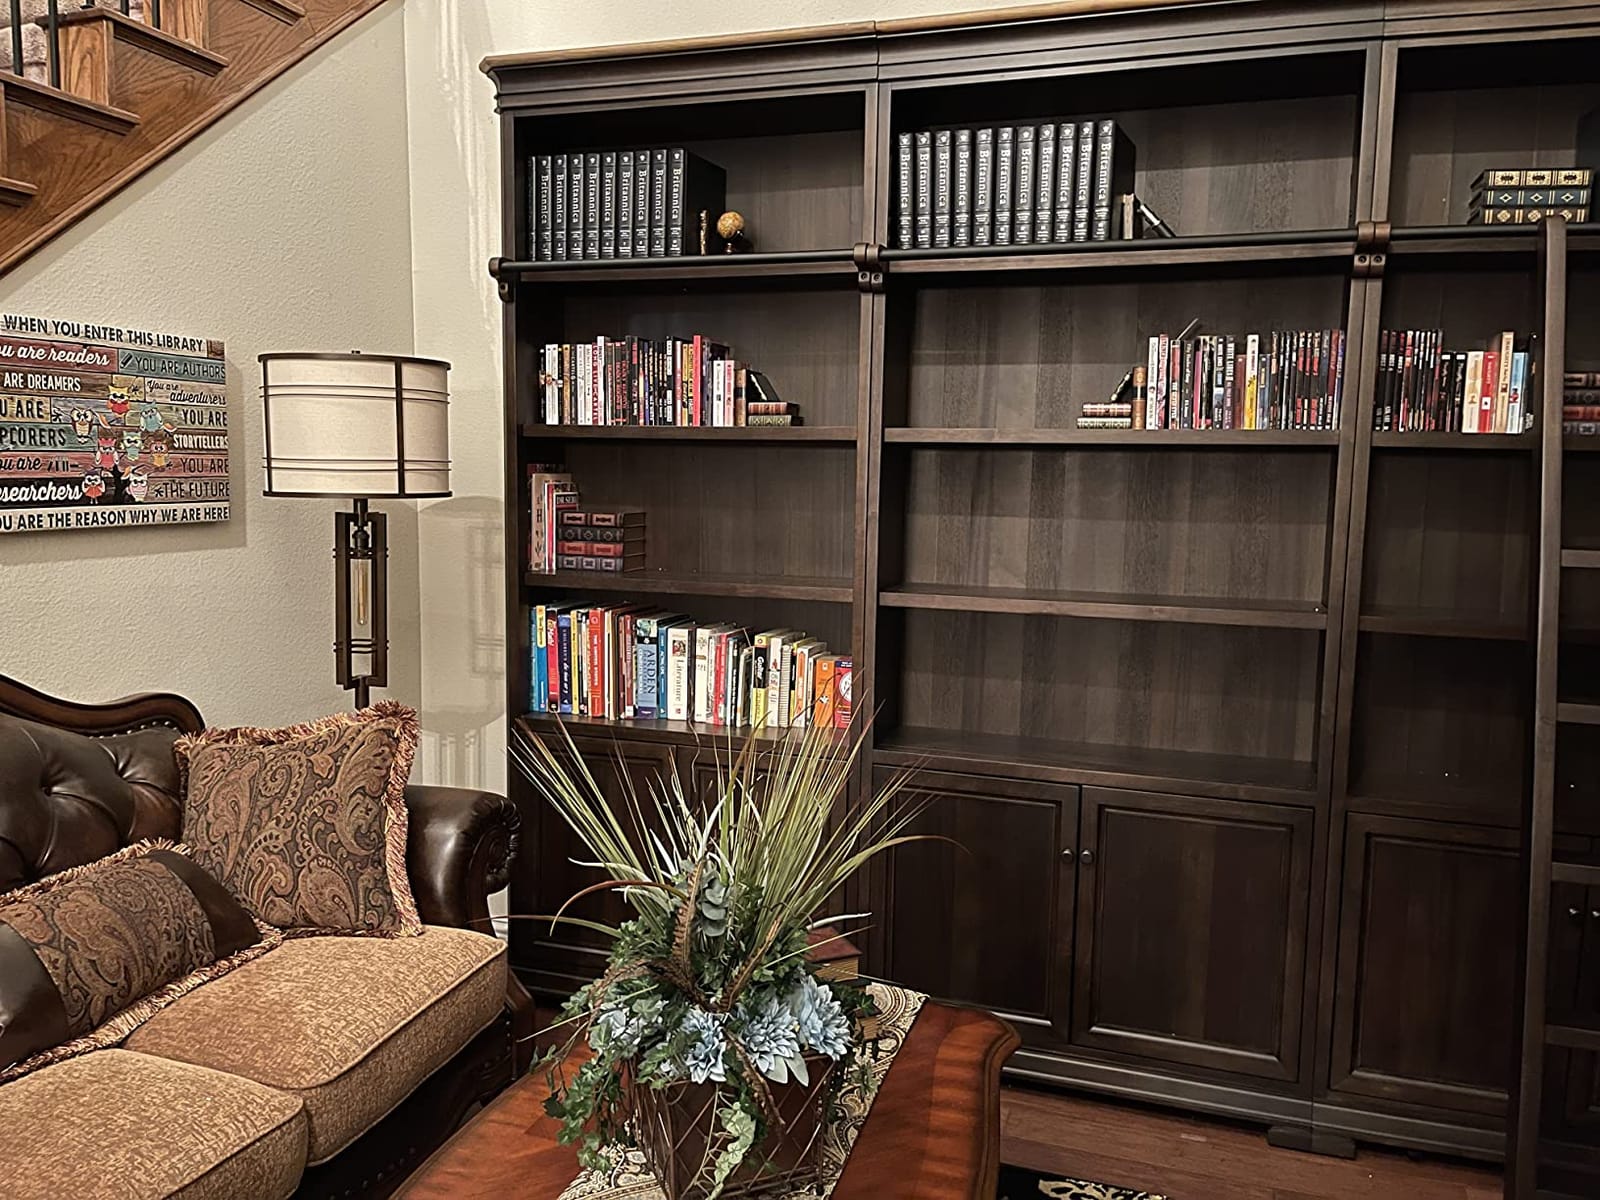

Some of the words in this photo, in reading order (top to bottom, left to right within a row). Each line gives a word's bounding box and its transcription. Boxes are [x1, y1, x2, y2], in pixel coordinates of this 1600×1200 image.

[638, 170, 647, 221] Britannica
[655, 170, 664, 220] Britannica
[672, 168, 682, 219] Britannica
[901, 154, 910, 208] Britannica
[920, 154, 929, 208] Britannica
[939, 152, 949, 207] Britannica
[959, 151, 968, 206] Britannica
[978, 150, 989, 205] Britannica
[1000, 149, 1010, 205] Britannica
[1020, 148, 1031, 204] Britannica
[1041, 147, 1052, 203] Britannica
[1060, 145, 1073, 202] Britannica
[1079, 144, 1091, 201] Britannica
[1099, 142, 1111, 200] Britannica
[540, 175, 548, 224] Britannica
[556, 174, 564, 223] Britannica
[572, 173, 580, 223] Britannica
[588, 173, 597, 222] Britannica
[605, 172, 613, 222] Britannica
[621, 171, 630, 221] Britannica
[4, 315, 47, 333] WHEN
[52, 320, 80, 337] YOU
[85, 325, 123, 342] ENTER
[127, 330, 153, 346] THIS
[156, 334, 203, 351] LIBRARY
[17, 346, 47, 359] are
[48, 347, 110, 366] readers
[4, 372, 24, 387] ARE
[28, 374, 81, 391] DREAMERS
[136, 357, 156, 372] YOU
[160, 360, 179, 374] ARE
[183, 362, 226, 378] AUTHORS
[147, 380, 165, 392] You
[16, 400, 44, 418] ARE
[182, 409, 203, 425] YOU
[209, 411, 227, 426] ARE
[17, 456, 42, 470] are
[173, 434, 229, 449] STORYTELLERS
[180, 458, 204, 473] YOU
[210, 459, 229, 473] ARE
[163, 482, 184, 498] THE
[189, 482, 229, 497] FUTURE
[17, 514, 43, 529] ARE
[47, 513, 71, 528] THE
[76, 509, 126, 526] REASON
[130, 509, 157, 523] WHY
[161, 509, 177, 521] WE
[181, 508, 201, 521] ARE
[647, 650, 656, 694] ARDEN
[675, 659, 684, 701] Literature
